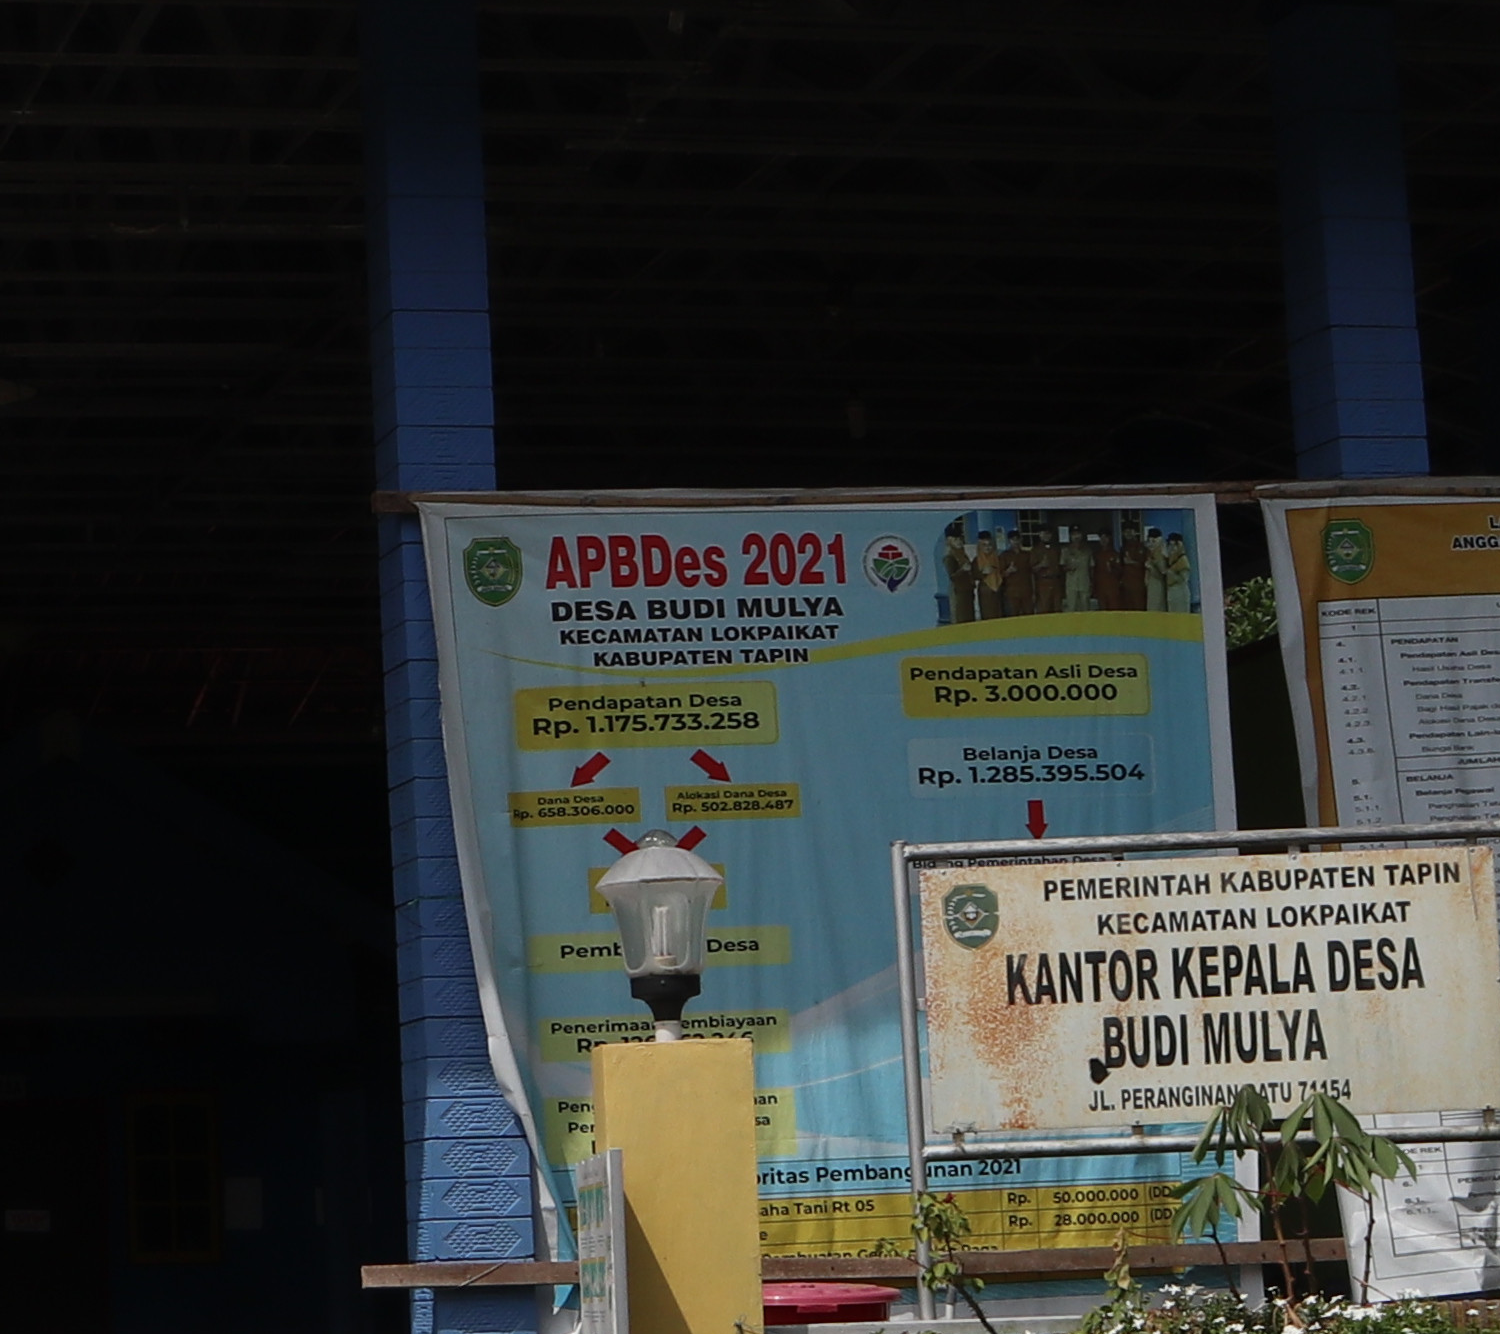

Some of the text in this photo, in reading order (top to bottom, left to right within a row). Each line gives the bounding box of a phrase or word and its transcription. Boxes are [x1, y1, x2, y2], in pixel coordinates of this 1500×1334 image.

[545, 532, 847, 590] APBDes 2021
[551, 596, 844, 622] DESA BUDI MULYA
[560, 624, 839, 645] KECAMATAN LOKPAIKAT
[594, 648, 809, 667] KABUPATEN TAPIN
[910, 664, 1138, 683] Pendapatan Asli Desa
[548, 693, 742, 716] Pendapatan Desa
[934, 683, 1118, 707] Rp. 3.000.000
[532, 712, 760, 740] Rp. 1.175.733.258
[962, 745, 1098, 765] Belanja Desa
[918, 763, 1145, 788] Rp. 1.285.395.504
[537, 794, 604, 806] Dana Desa
[538, 804, 635, 818] 658.306.000
[701, 799, 794, 813] 502.828.487
[1043, 862, 1462, 903] PEMERINTAH KABUPATEN TAPIN
[1097, 901, 1412, 936] KECAMATAN LOKPAIKAT
[706, 937, 760, 953] Desa
[1006, 937, 1425, 1007] KANTOR KEPALA DESA
[1102, 1008, 1328, 1069] BUDI MULYA
[1089, 1084, 1239, 1113] JL. PERANGINAN
[979, 1158, 1021, 1176] 2021
[793, 1188, 1139, 1215] Tani Rt 05 50.000.000
[1054, 1210, 1140, 1226] 28.000.000
